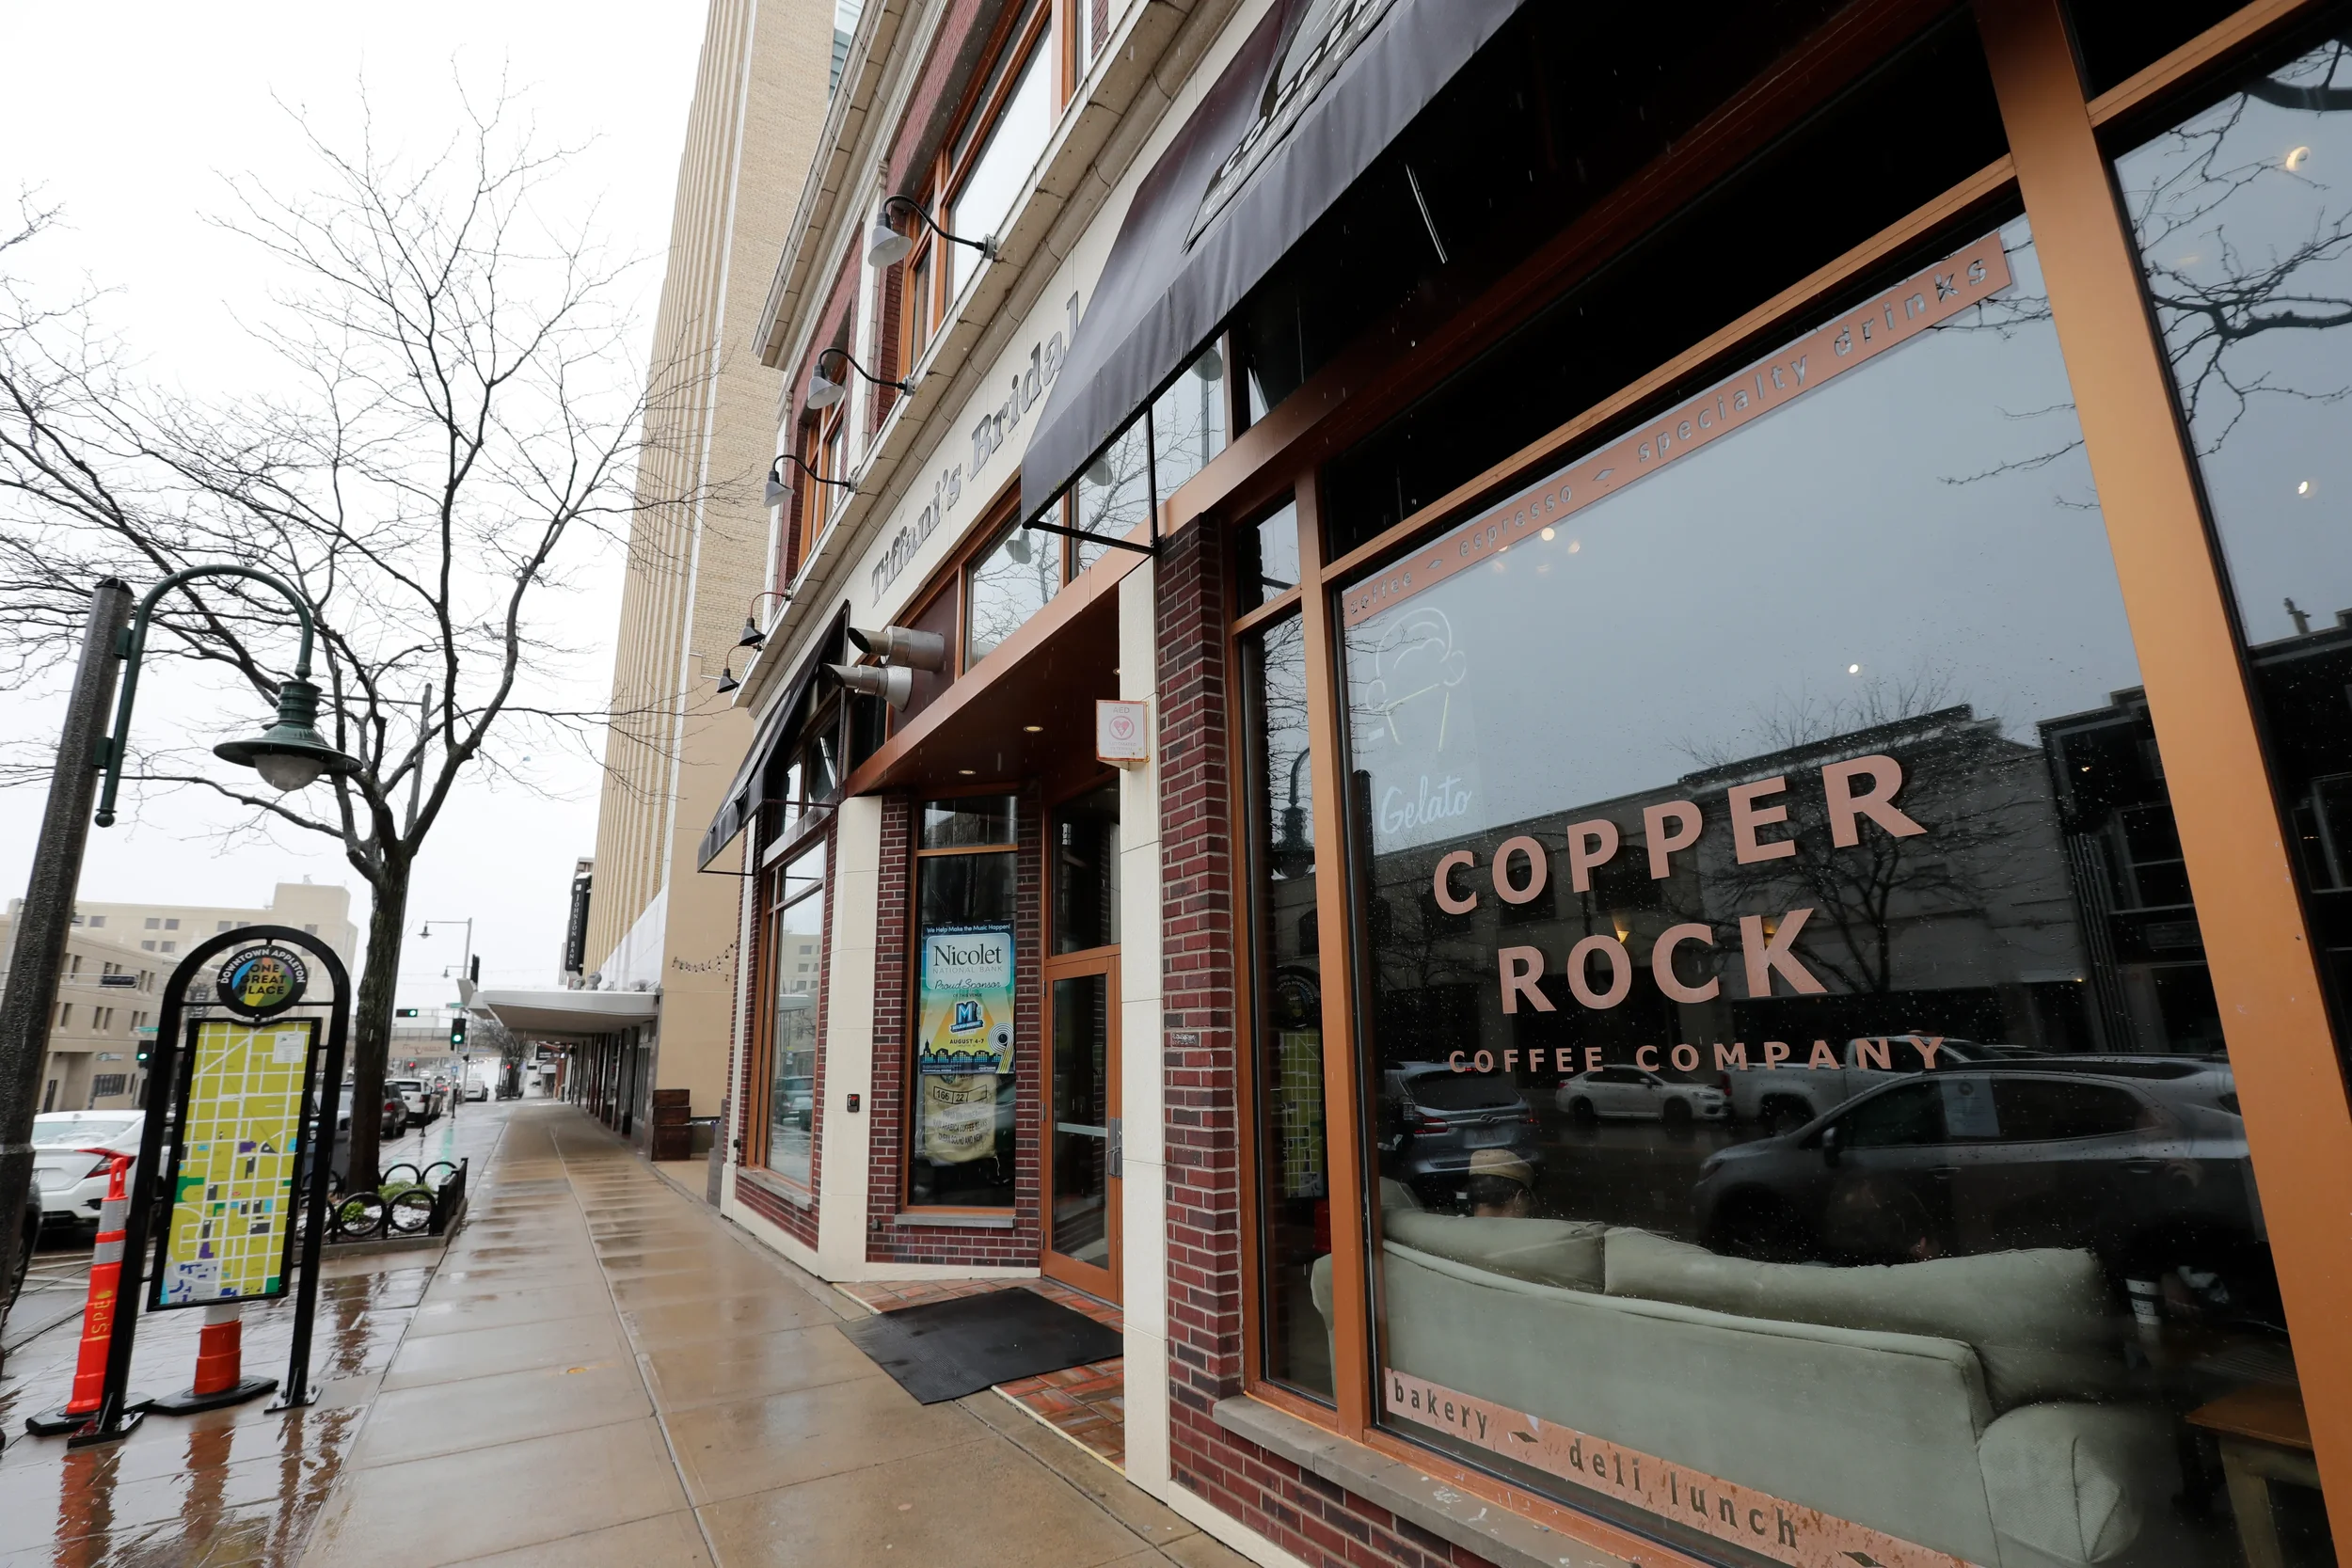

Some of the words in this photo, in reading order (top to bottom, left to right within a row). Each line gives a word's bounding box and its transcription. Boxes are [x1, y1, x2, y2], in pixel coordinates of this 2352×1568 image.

[1459, 485, 1573, 557] espresso
[1638, 355, 1808, 462] specialty
[1834, 258, 1988, 357] drinks
[871, 463, 961, 610] Tiffani's
[970, 290, 1079, 482] Bridal
[1379, 774, 1472, 835] Gelato
[1433, 754, 1928, 915] COPPER
[571, 894, 580, 937] JOHNSON
[220, 949, 270, 984] DOWNTOWN
[271, 949, 306, 983] APPLETON
[249, 964, 279, 973] ONE
[933, 943, 1003, 966] Nicolet
[1498, 908, 1828, 1015] ROCK
[239, 986, 284, 994] PLACE
[242, 974, 286, 984] GREAT
[935, 978, 962, 990] Proud
[962, 978, 1001, 990] Sponsor
[1449, 1046, 1603, 1073] COFFEE
[1635, 1037, 1943, 1072] COMPANY
[937, 1090, 949, 1101] 166
[1394, 1376, 1488, 1440] bakery
[1569, 1438, 1643, 1494] deli
[1669, 1471, 1801, 1553] lunch
